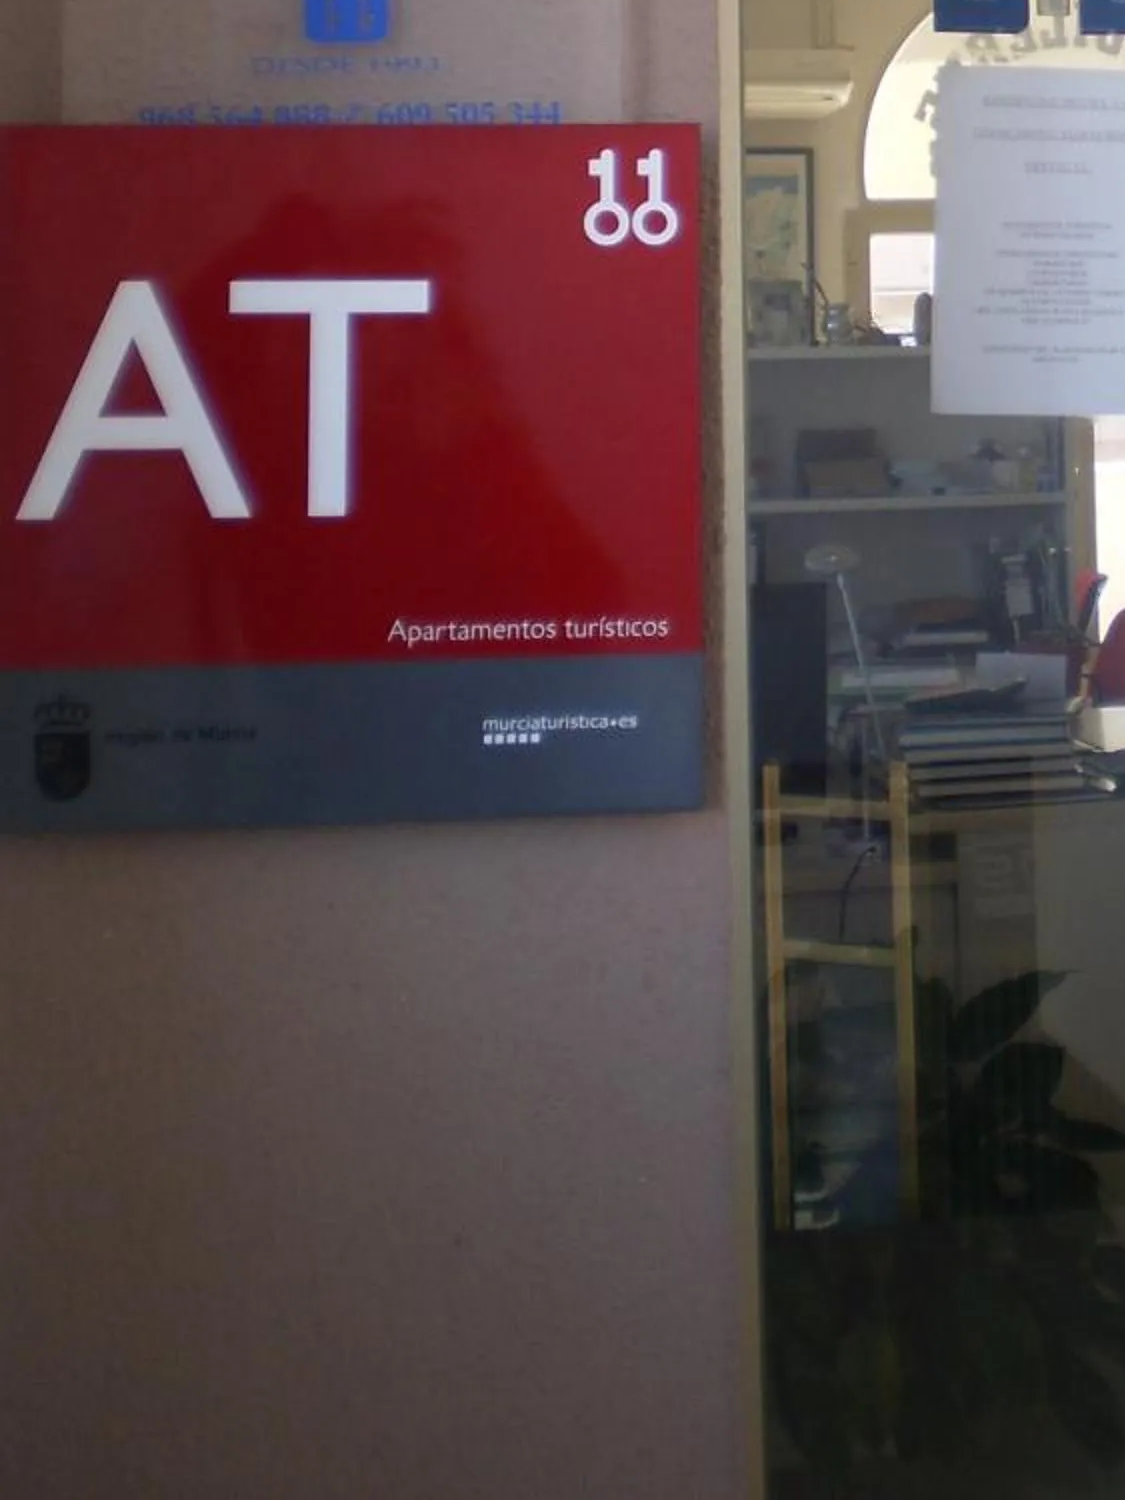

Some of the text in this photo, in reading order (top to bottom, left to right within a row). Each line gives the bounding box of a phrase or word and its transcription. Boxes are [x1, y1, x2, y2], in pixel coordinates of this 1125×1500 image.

[15, 280, 430, 521] AT
[388, 614, 669, 648] Apartamentos turísticos
